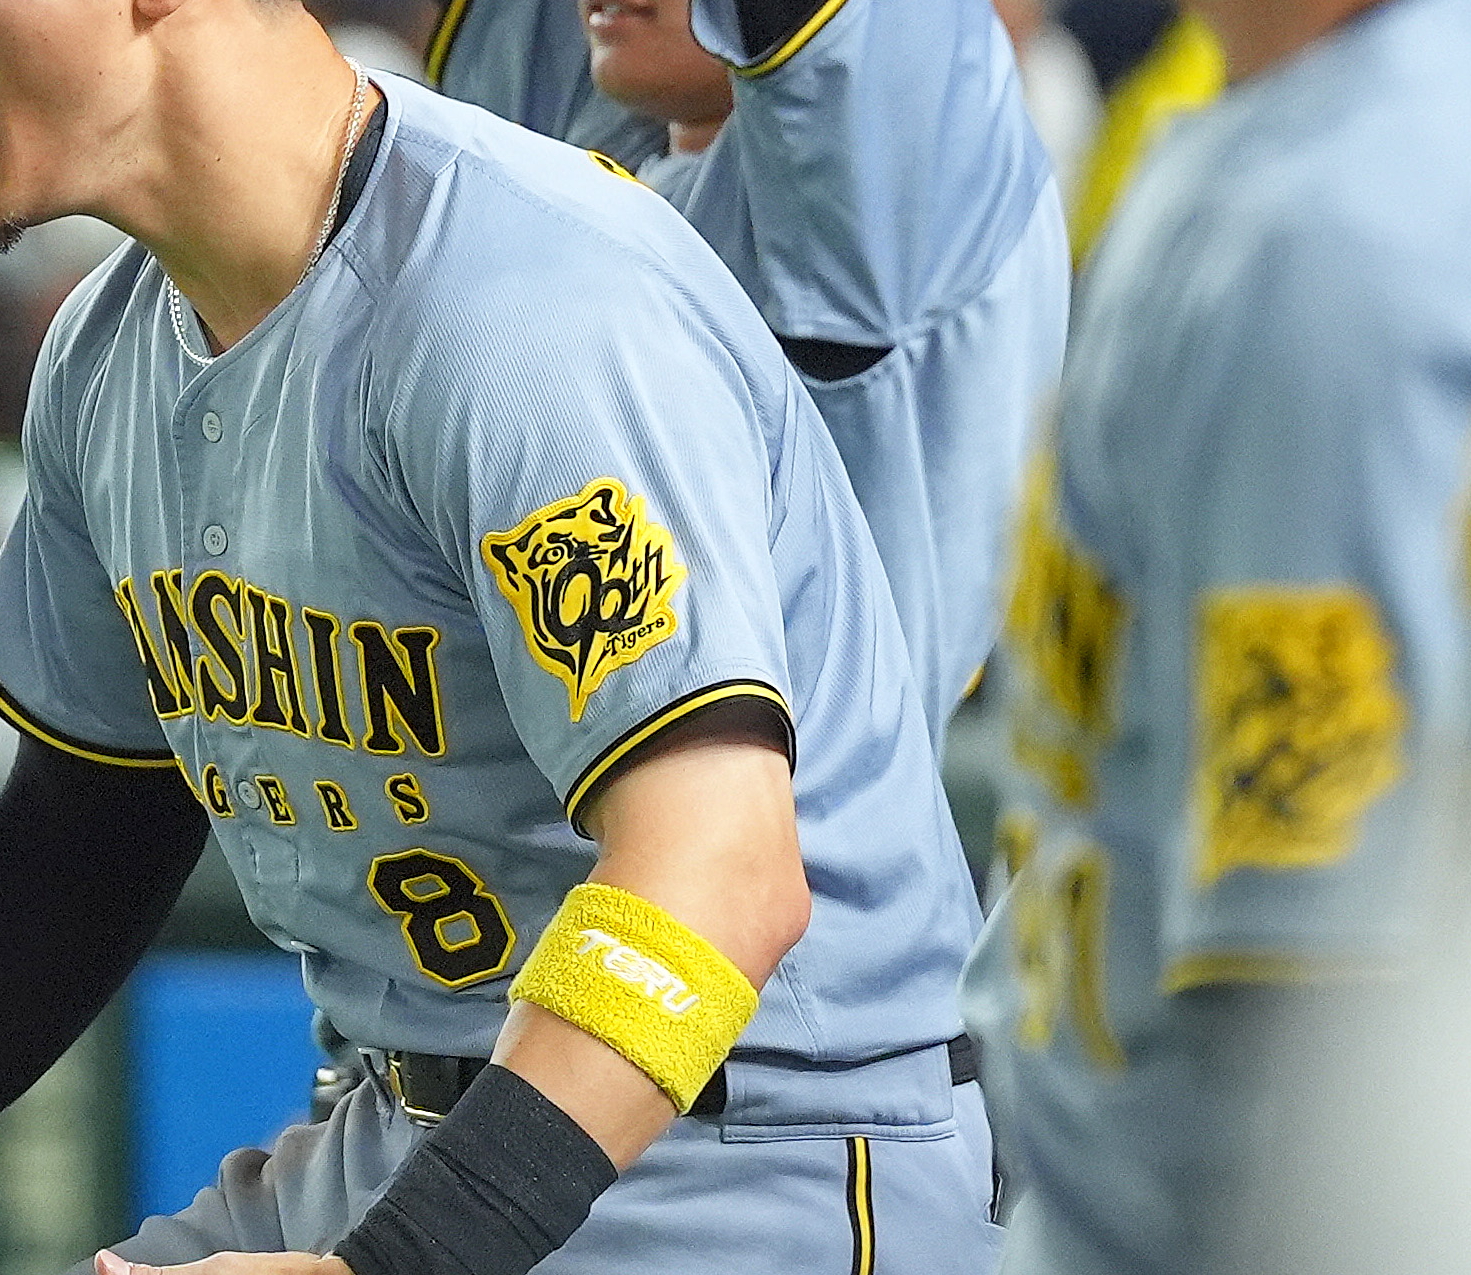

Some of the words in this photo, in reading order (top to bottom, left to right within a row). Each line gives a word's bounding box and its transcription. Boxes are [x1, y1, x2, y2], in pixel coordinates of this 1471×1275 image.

[602, 617, 666, 659] Tigers
[190, 760, 430, 831] GERS
[366, 847, 517, 989] 8
[576, 929, 701, 1015] TERU
